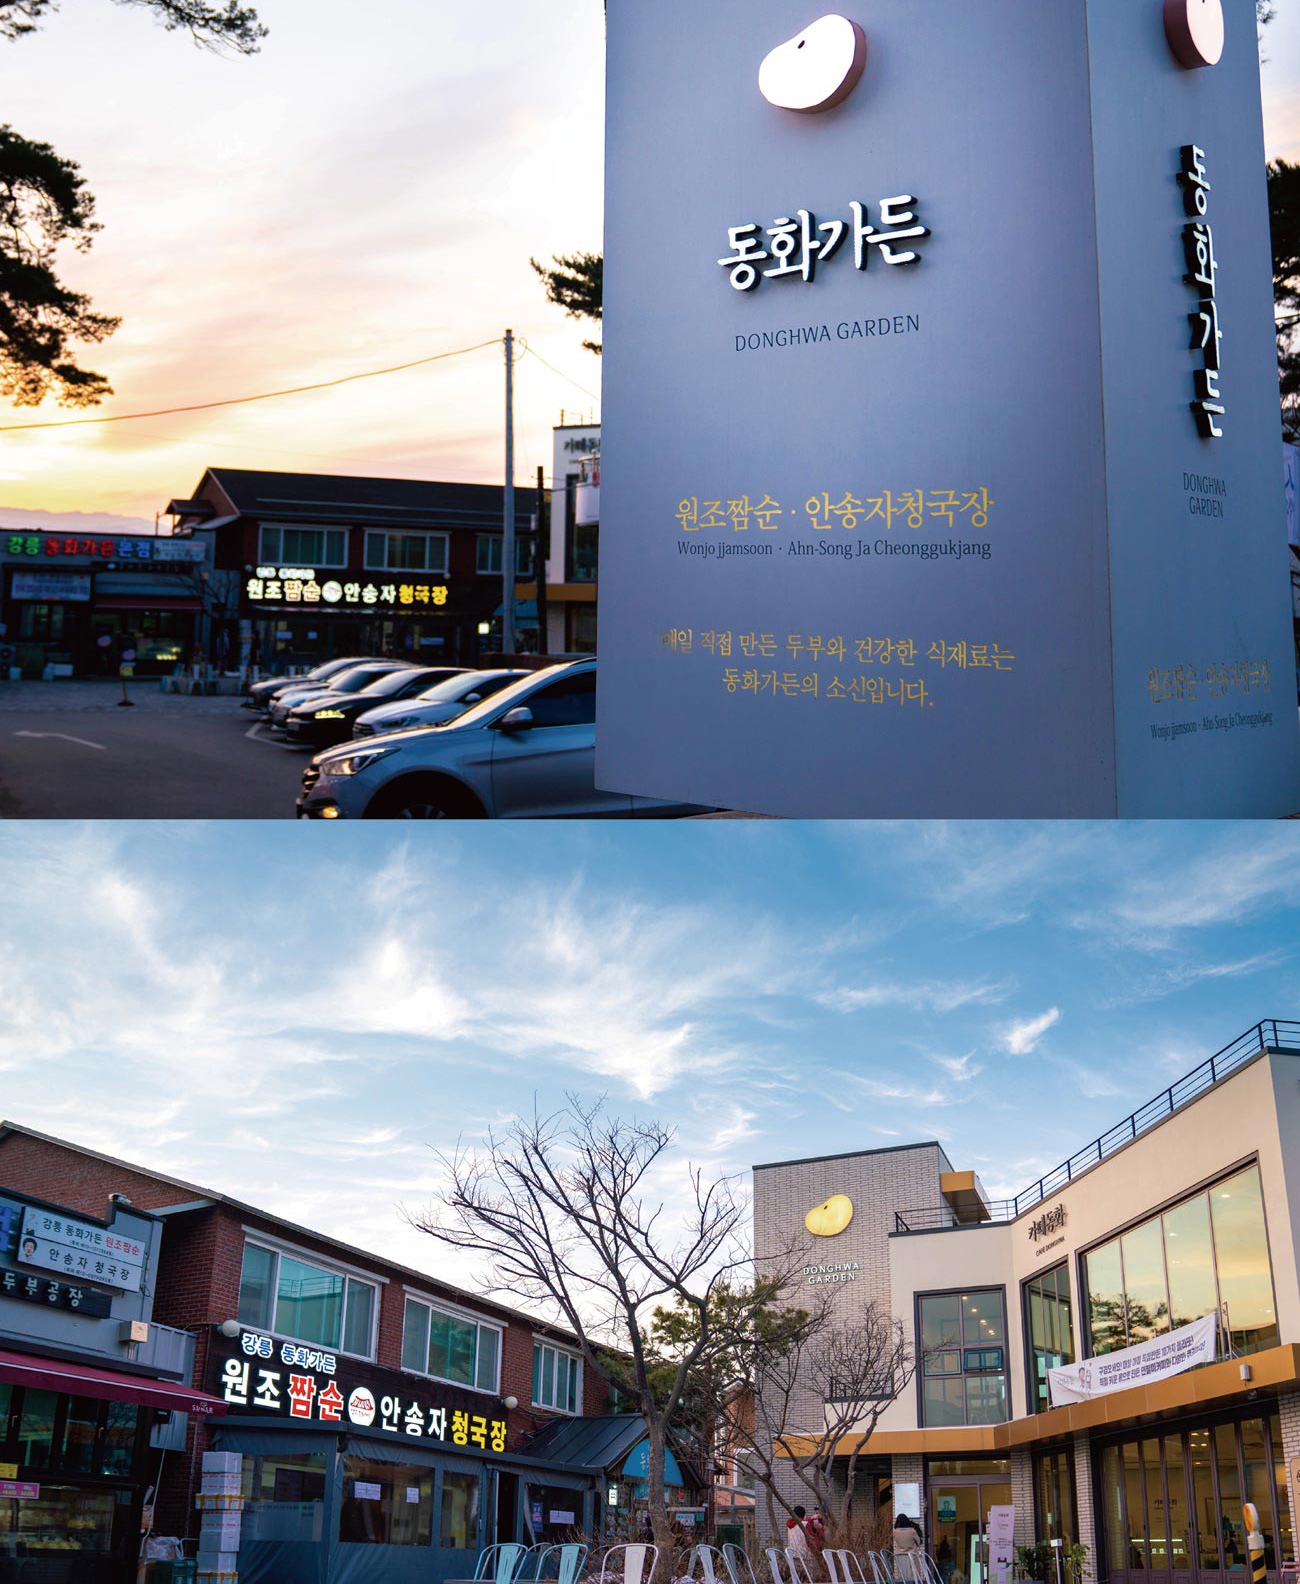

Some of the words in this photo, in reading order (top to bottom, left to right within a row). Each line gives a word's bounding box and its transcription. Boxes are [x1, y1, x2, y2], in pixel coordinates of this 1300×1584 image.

[717, 194, 930, 292] 동화가든
[1177, 144, 1224, 438] 동화가든
[735, 327, 832, 352] DONGHWA
[836, 314, 920, 340] GARDEN
[1183, 472, 1227, 497] DONGHWA
[675, 495, 782, 532] 원조짬순
[804, 487, 995, 529] 안송자청국장
[1189, 496, 1224, 519] GARDEN
[8, 536, 41, 555] 강릉
[677, 540, 716, 559] Wonjo
[717, 540, 773, 560] jjamsoon
[787, 540, 852, 561] Ahn-Song
[855, 541, 872, 557] Ja
[873, 540, 992, 561] Cheonggukjang
[662, 628, 693, 654] 매일
[699, 630, 732, 656] 직접
[739, 633, 778, 658] 만든
[785, 634, 847, 663] 두부와
[854, 637, 918, 667] 건강한
[925, 639, 1015, 671] 식재료는
[722, 668, 819, 699] 동화가든의
[825, 675, 934, 707] 소신입니다.
[42, 1217, 63, 1233] 강릉
[65, 1224, 103, 1245] 동화가든
[1027, 1203, 1068, 1243] 카페동화
[803, 1262, 860, 1276] DONGHWA
[808, 1272, 857, 1285] GARDEN
[241, 1333, 273, 1359] 강릉
[280, 1343, 337, 1375] 동화가든
